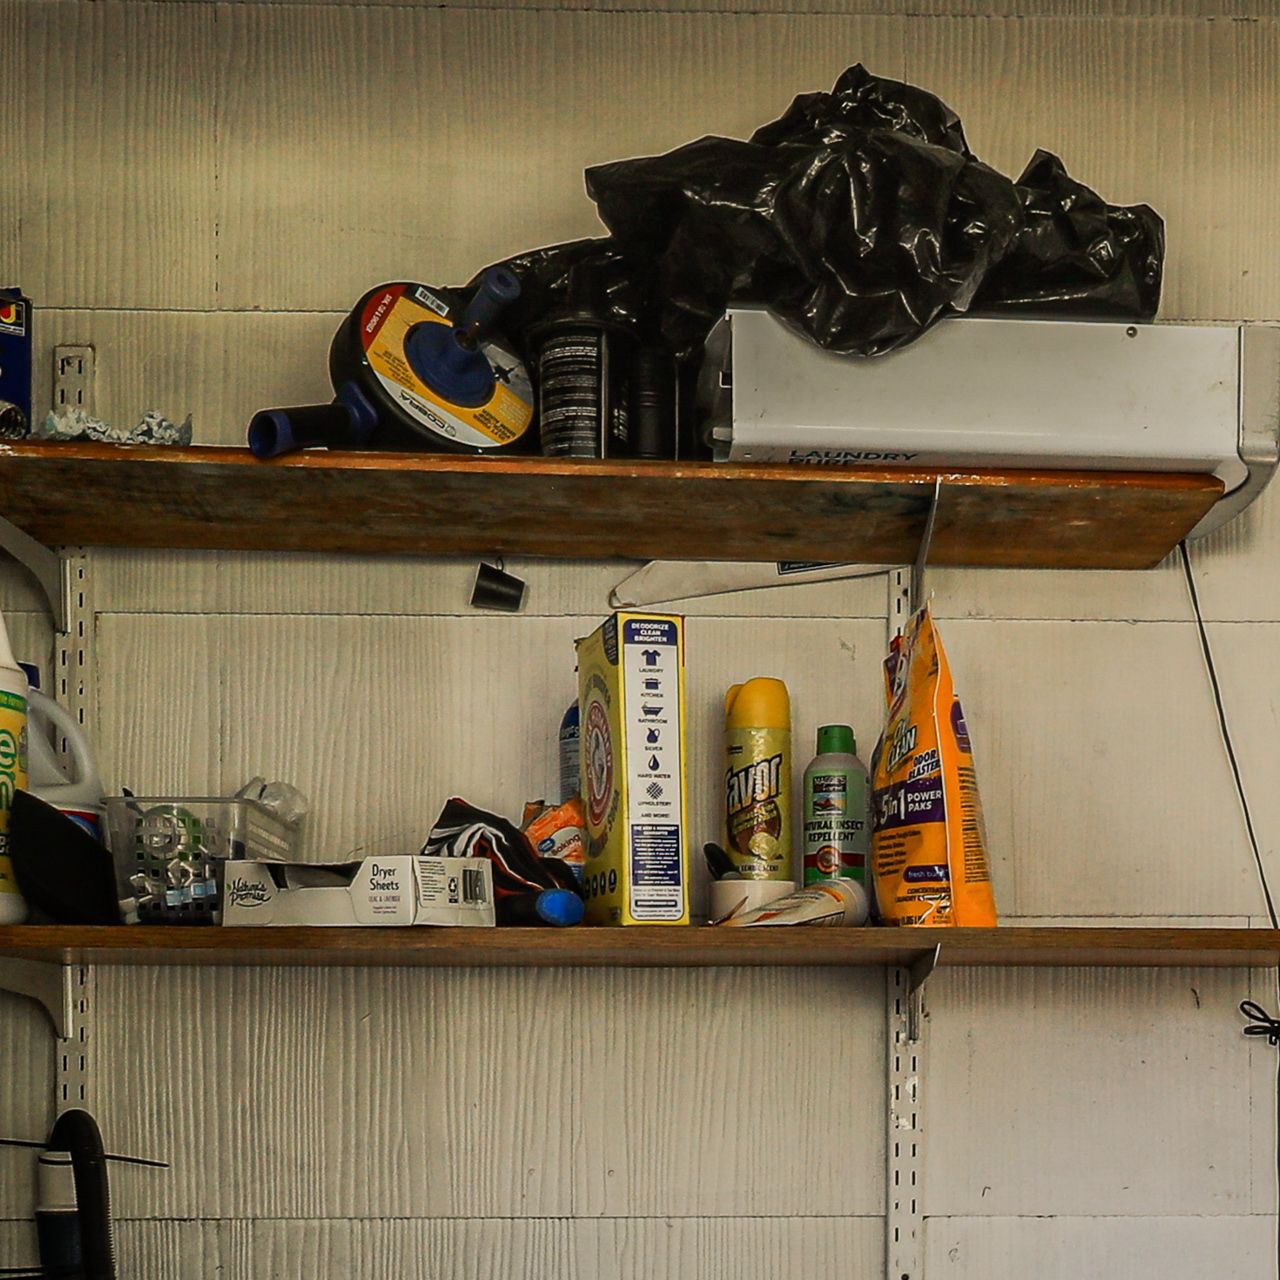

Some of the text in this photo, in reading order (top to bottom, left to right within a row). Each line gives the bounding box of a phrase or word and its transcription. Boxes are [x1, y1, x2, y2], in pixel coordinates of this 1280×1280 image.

[400, 391, 446, 431] COBRA
[790, 450, 919, 461] LAUNDRY
[631, 622, 669, 630] DEODORIZE
[634, 635, 667, 643] BRIGHTEN
[914, 749, 937, 767] ODOR
[907, 790, 943, 802] POWER
[835, 820, 864, 831] INSECT
[808, 832, 855, 842] REPELLENT
[372, 863, 397, 880] Dryer
[370, 878, 400, 891] Sheets
